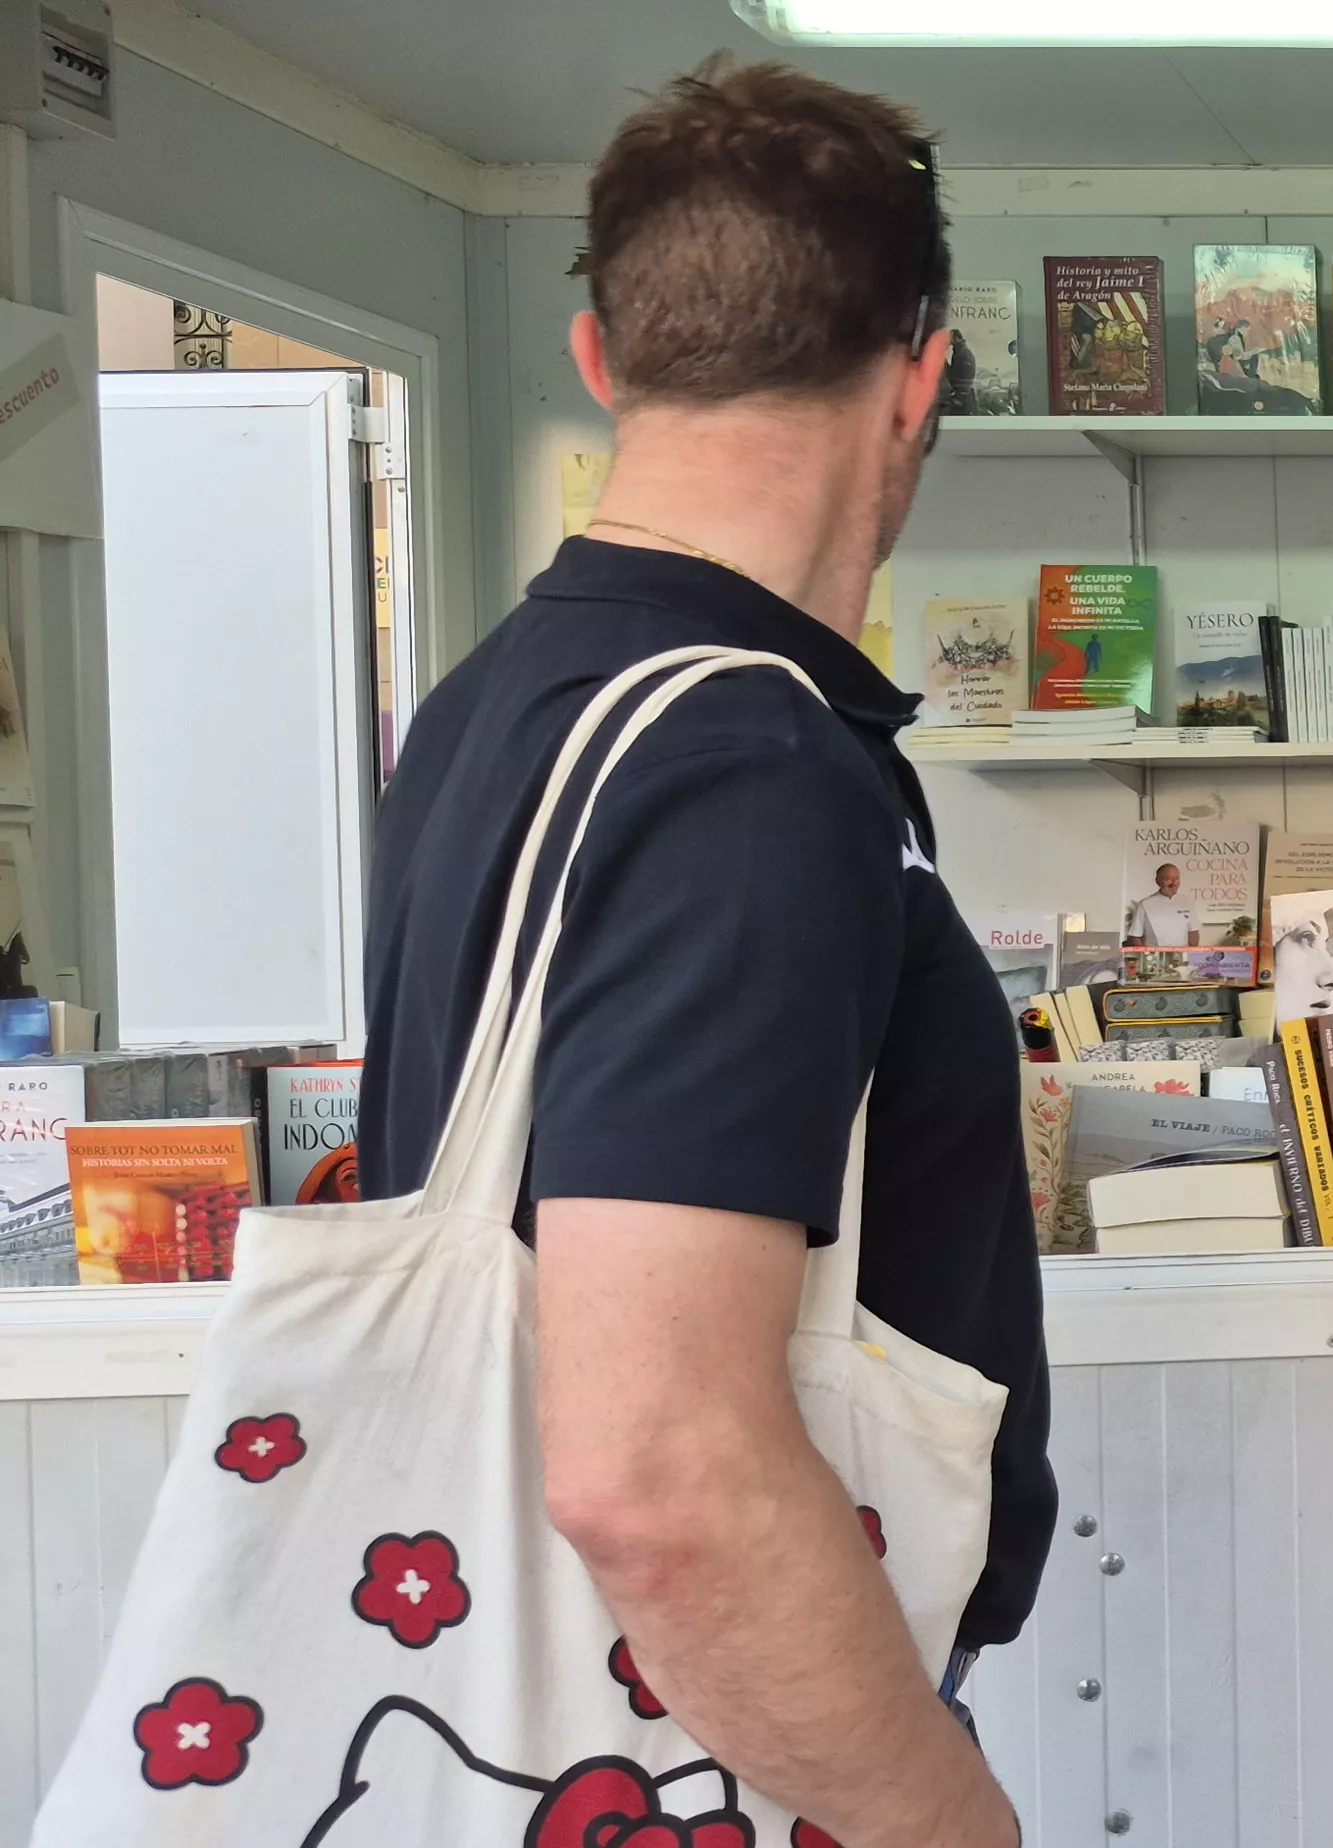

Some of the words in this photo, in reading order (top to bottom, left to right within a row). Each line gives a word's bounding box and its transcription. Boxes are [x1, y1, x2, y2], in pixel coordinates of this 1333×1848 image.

[1056, 266, 1101, 276] Historia
[1104, 268, 1112, 279] y
[1113, 267, 1140, 276] mito
[1056, 278, 1074, 289] del
[1076, 280, 1093, 291] rey
[1096, 275, 1134, 289] Jaime
[1136, 276, 1145, 288] I
[1057, 291, 1070, 300] de
[1073, 290, 1111, 302] Aragón
[950, 307, 1012, 320] NFRANC
[1064, 574, 1082, 584] UN
[1083, 574, 1133, 584] CUERPO
[1069, 596, 1096, 605] UNA
[1097, 596, 1126, 605] VIDA
[1071, 606, 1123, 615] INFINITA
[1186, 611, 1254, 630] YÉSERO
[1134, 827, 1199, 842] KARLOS
[1143, 837, 1251, 857] ARGUIÑANO
[1186, 858, 1250, 872] COCINA
[1210, 874, 1247, 886] PARA
[1189, 887, 1249, 901] TODOS
[989, 930, 1044, 946] Rolde
[1091, 1072, 1136, 1082] ANDREA
[290, 1076, 344, 1093] KATHRYN
[289, 1098, 305, 1119] EL
[314, 1097, 359, 1118] CLUB
[1151, 1118, 1170, 1129] EL
[1171, 1120, 1211, 1133] VIAJE
[1221, 1125, 1251, 1138] PACO
[1293, 1049, 1310, 1091] SUCESOS
[1303, 1094, 1320, 1142] CRÍTICOS
[1314, 1145, 1332, 1193] VARIADOS
[70, 1146, 109, 1157] SOBRE
[110, 1145, 137, 1157] TOT
[139, 1145, 161, 1156] NO
[161, 1144, 207, 1156] TOMAR
[208, 1144, 239, 1155] MAL
[82, 1157, 134, 1168] HISTORIAS
[1282, 1136, 1304, 1195] INVIERNO
